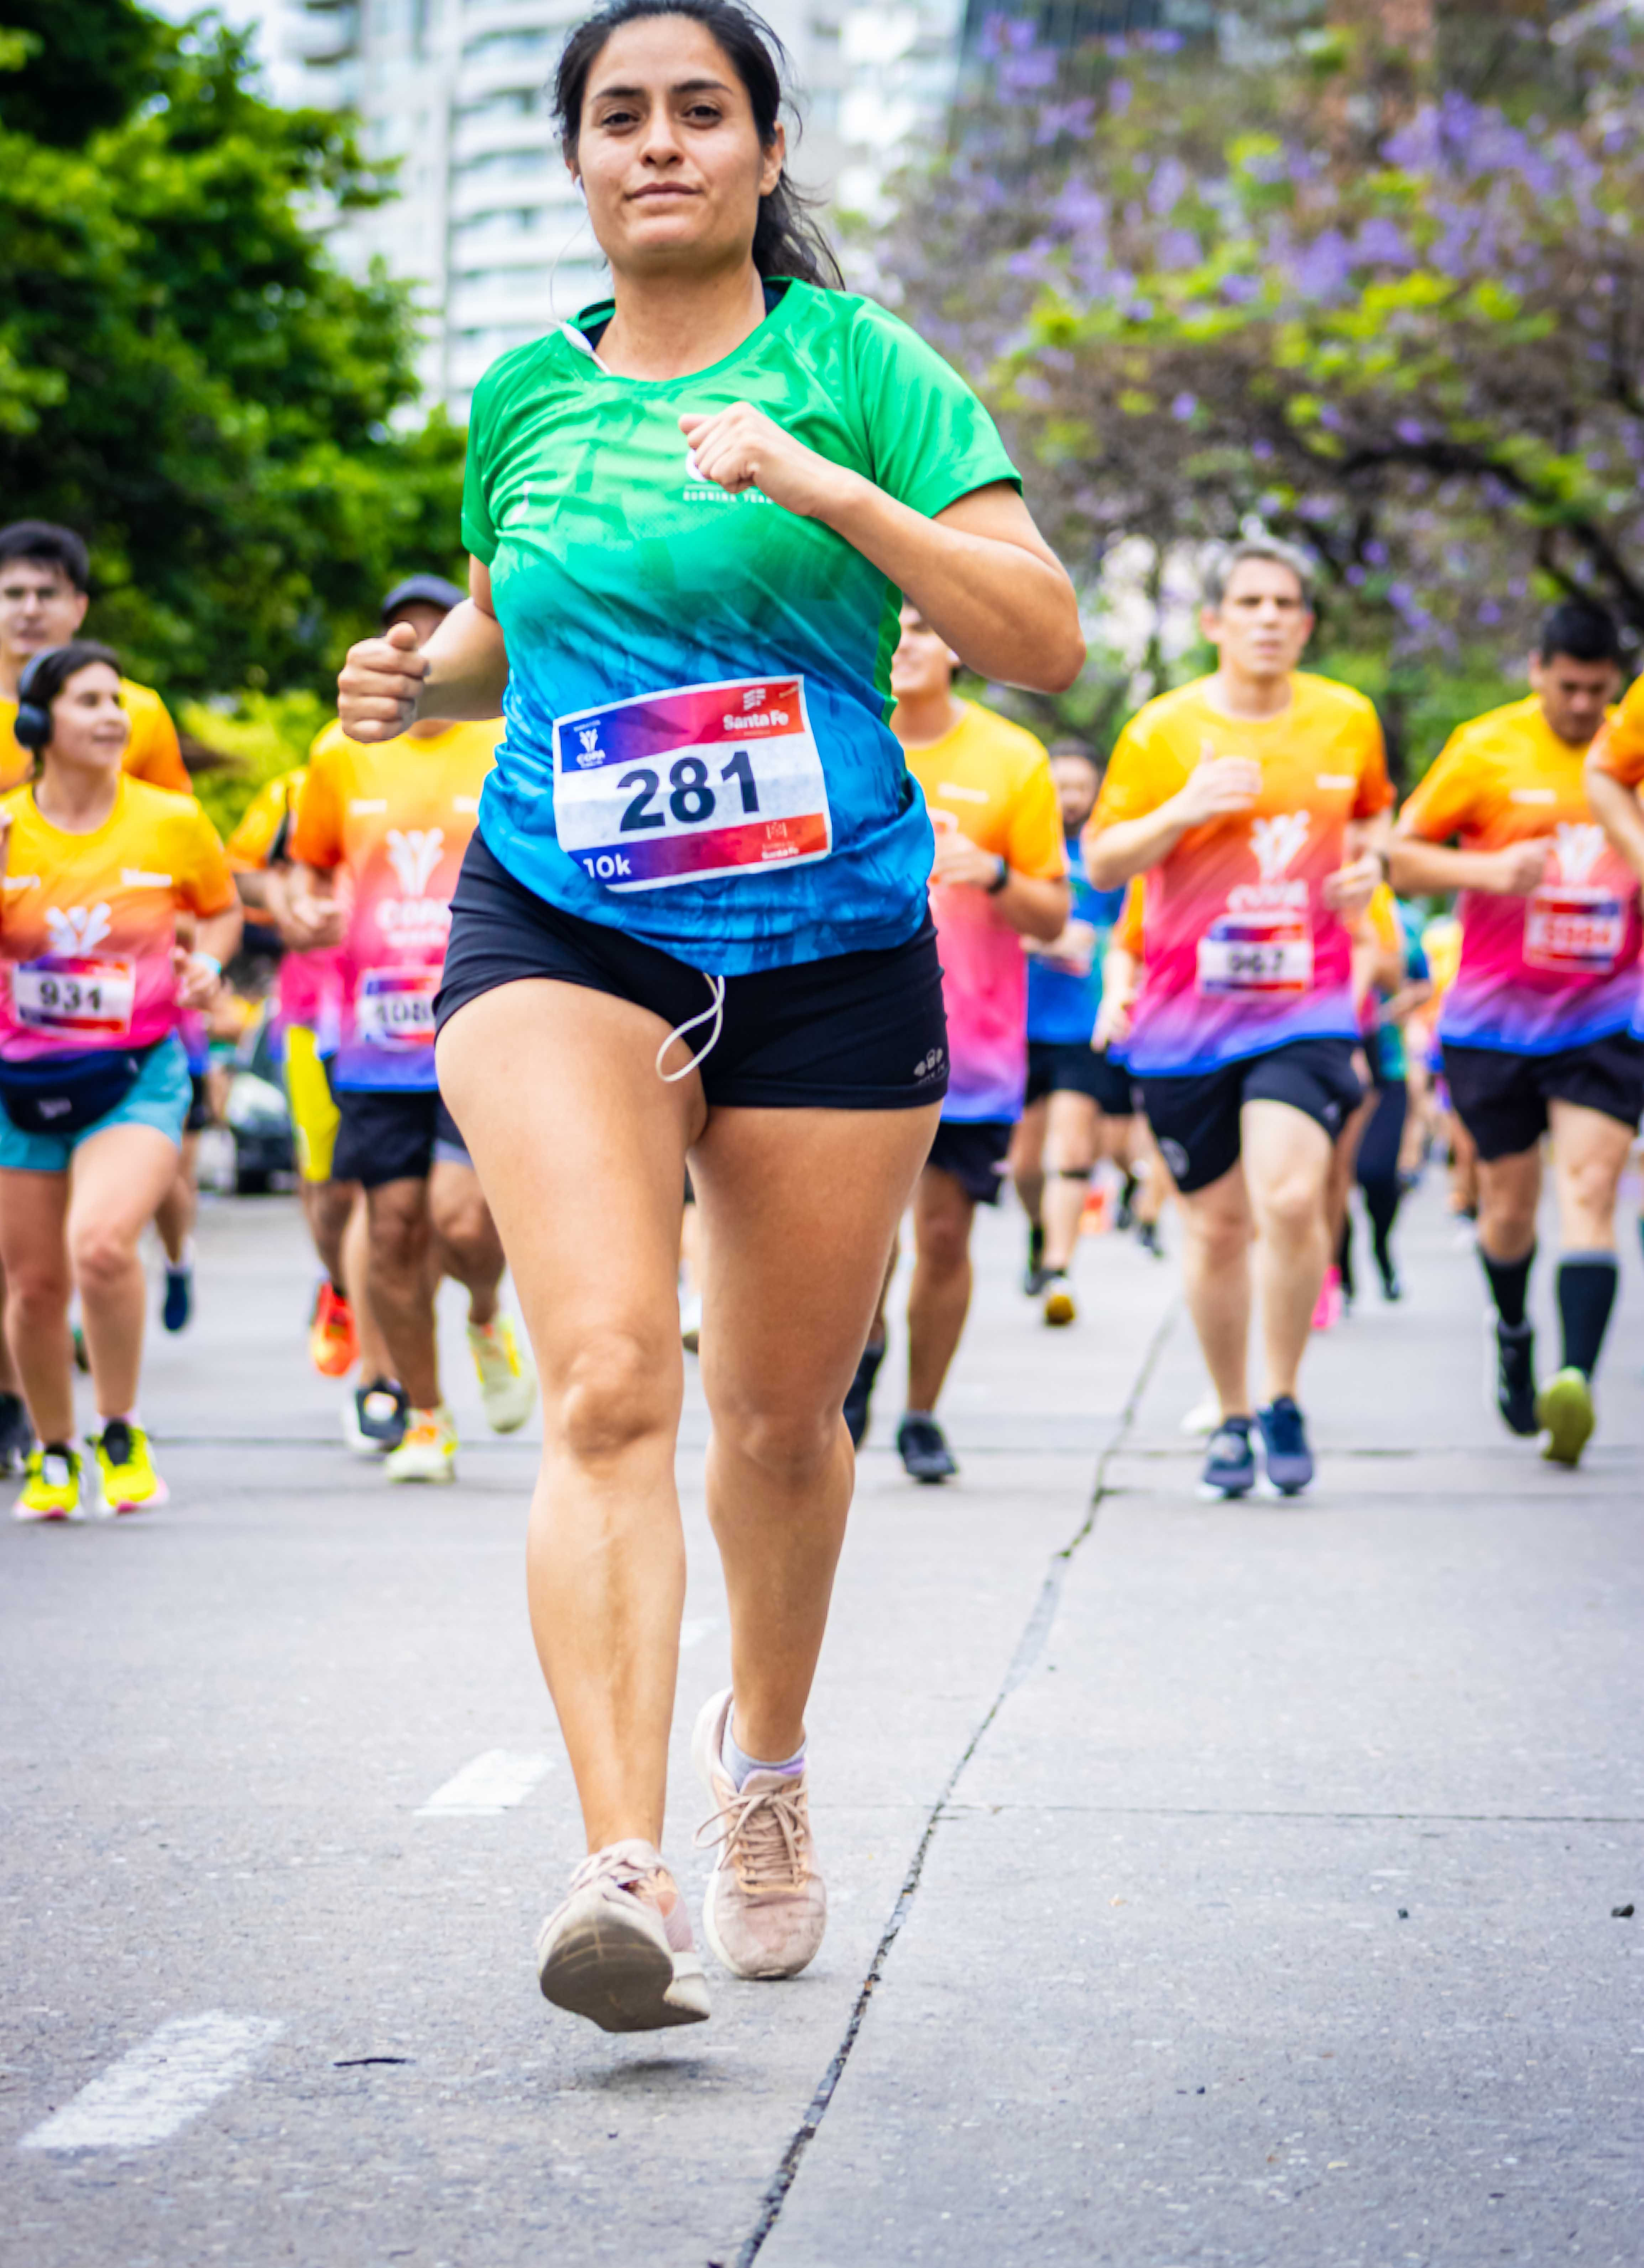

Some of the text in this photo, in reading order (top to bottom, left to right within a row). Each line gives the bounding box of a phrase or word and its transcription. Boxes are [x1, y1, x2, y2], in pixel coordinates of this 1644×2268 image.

[723, 710, 789, 730] Santa Fe
[616, 750, 760, 832] 281
[583, 853, 632, 878] 10k
[39, 980, 102, 1012] 931
